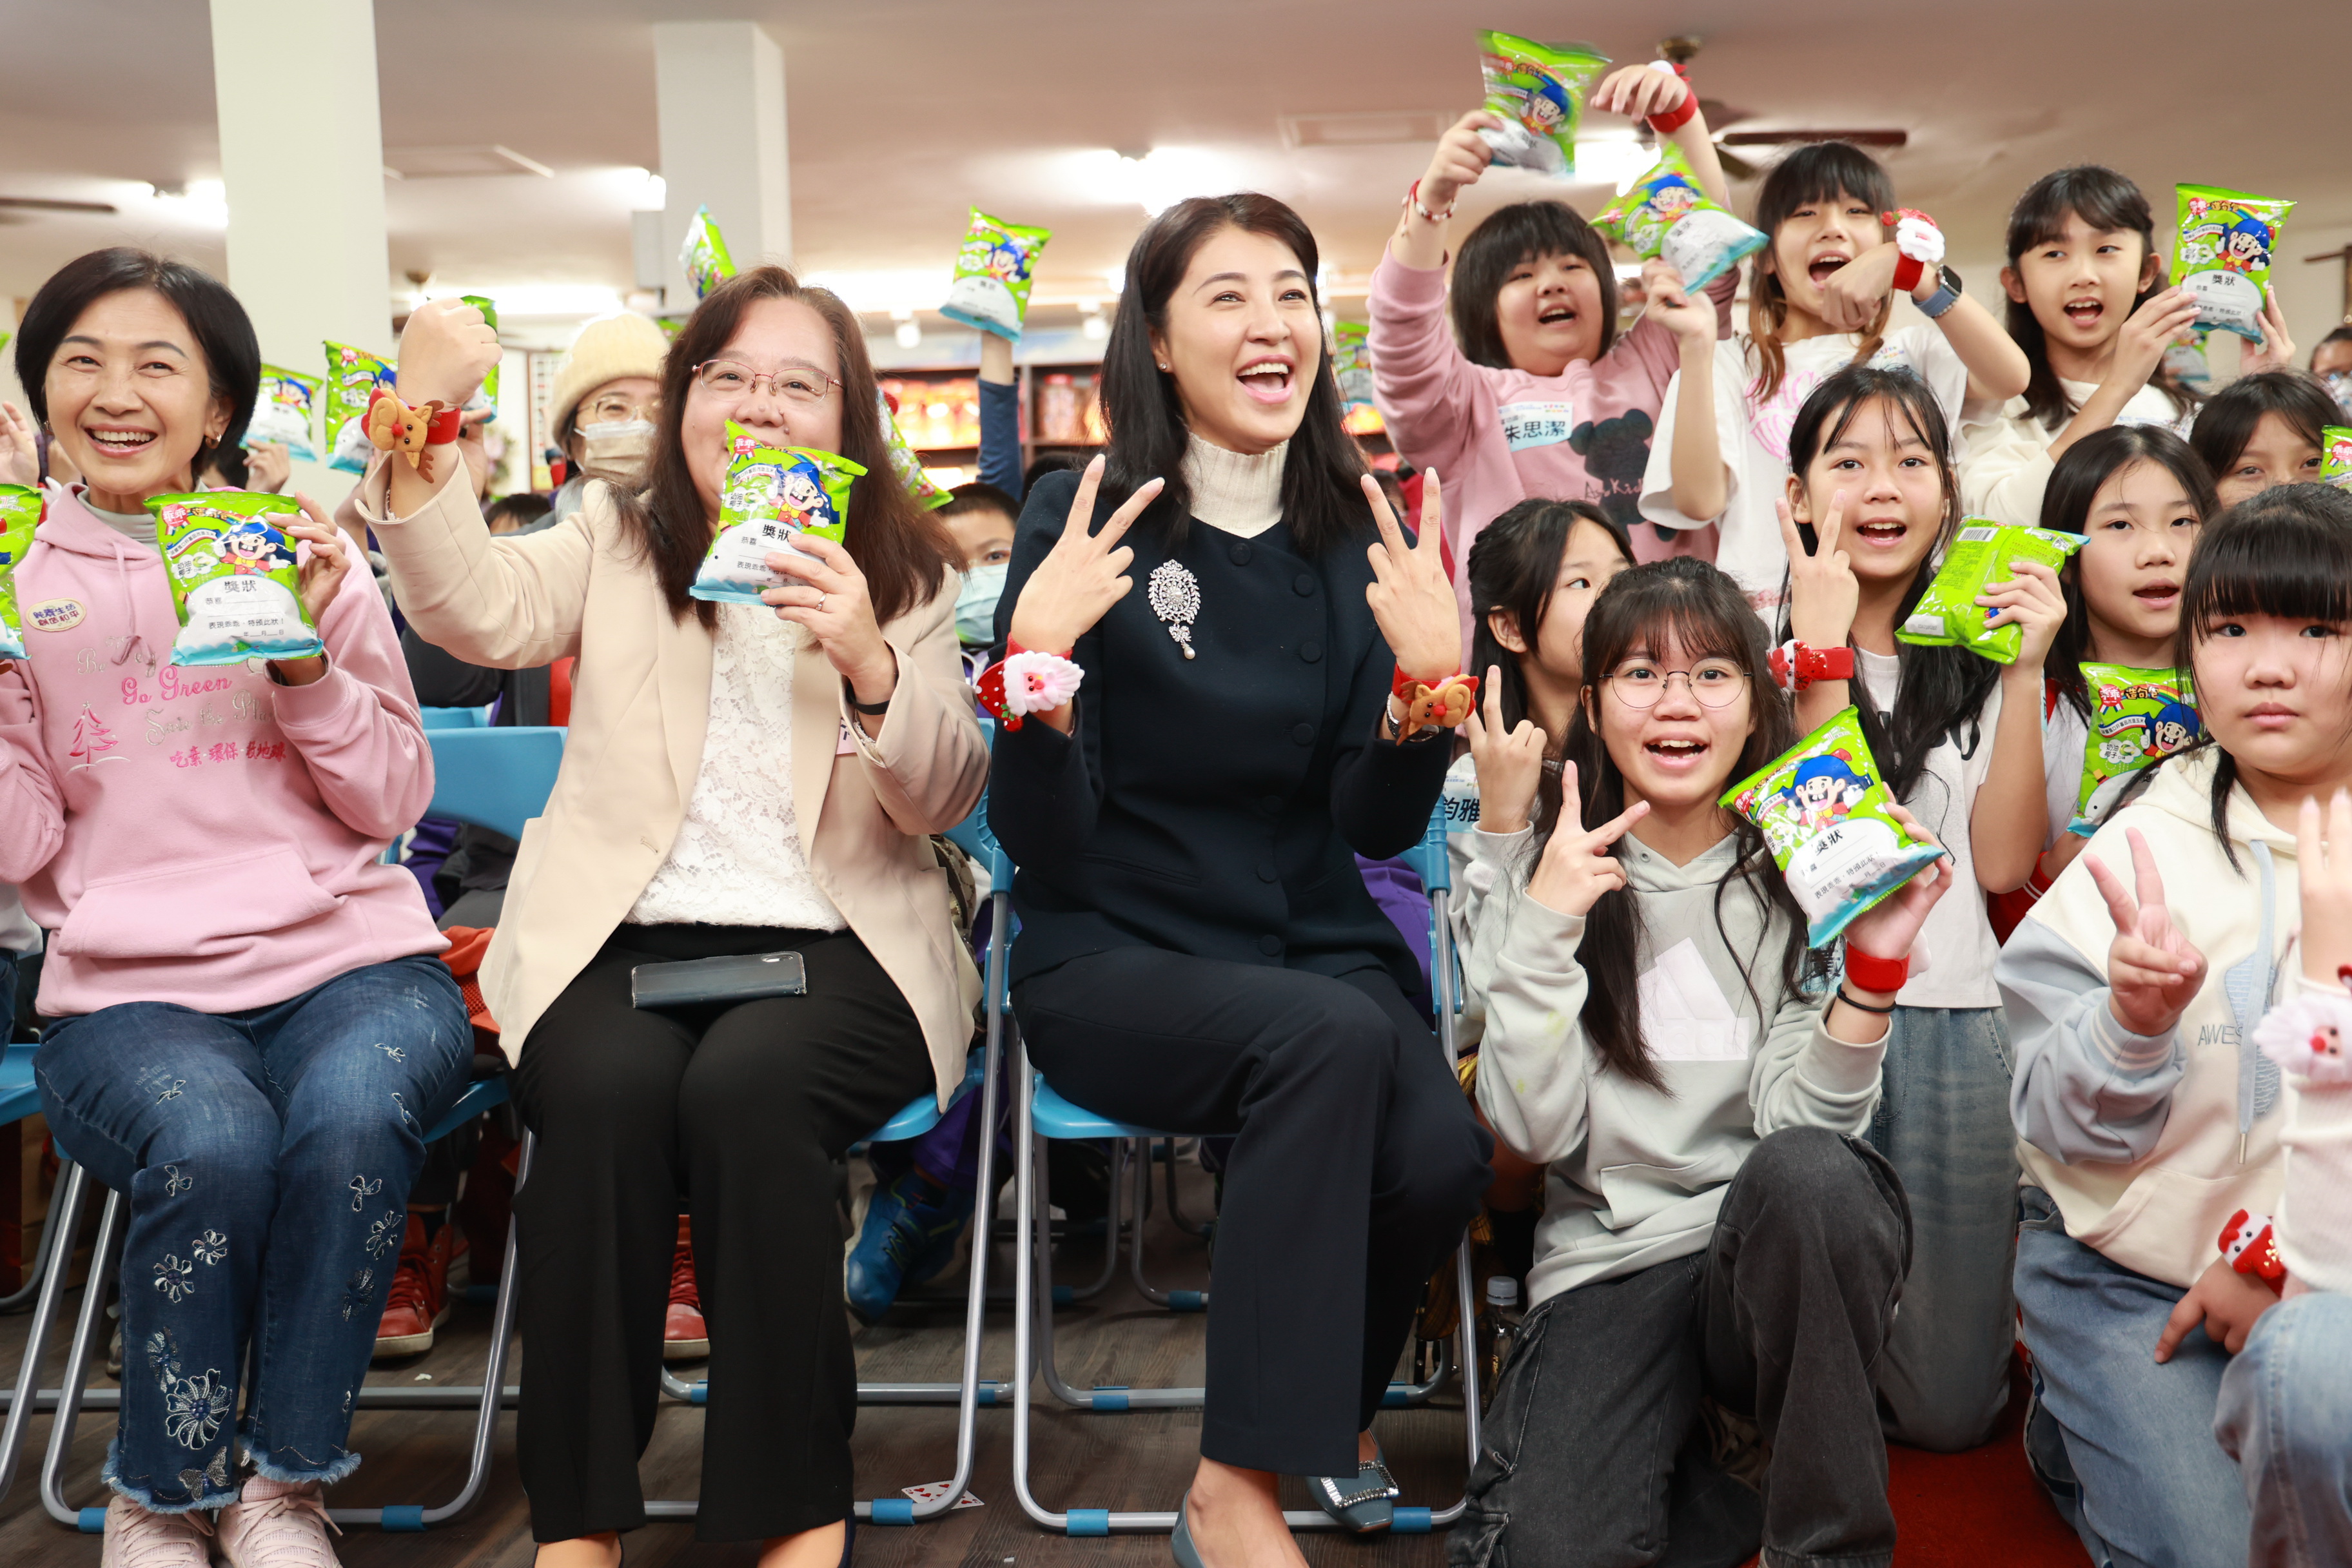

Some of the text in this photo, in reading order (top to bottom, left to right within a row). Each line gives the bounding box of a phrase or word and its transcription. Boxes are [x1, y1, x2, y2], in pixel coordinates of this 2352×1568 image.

[2212, 274, 2236, 286] 獎狀
[735, 438, 756, 449] 乖乖
[162, 507, 187, 522] 乖乖
[761, 524, 792, 543] 獎狀
[741, 536, 757, 546] 恭喜
[224, 580, 257, 593] 獎狀
[77, 647, 106, 675] Be
[121, 665, 233, 705] Go Green
[2099, 687, 2121, 701] 乖乖
[199, 701, 223, 726] the
[2106, 743, 2120, 752] 奶油
